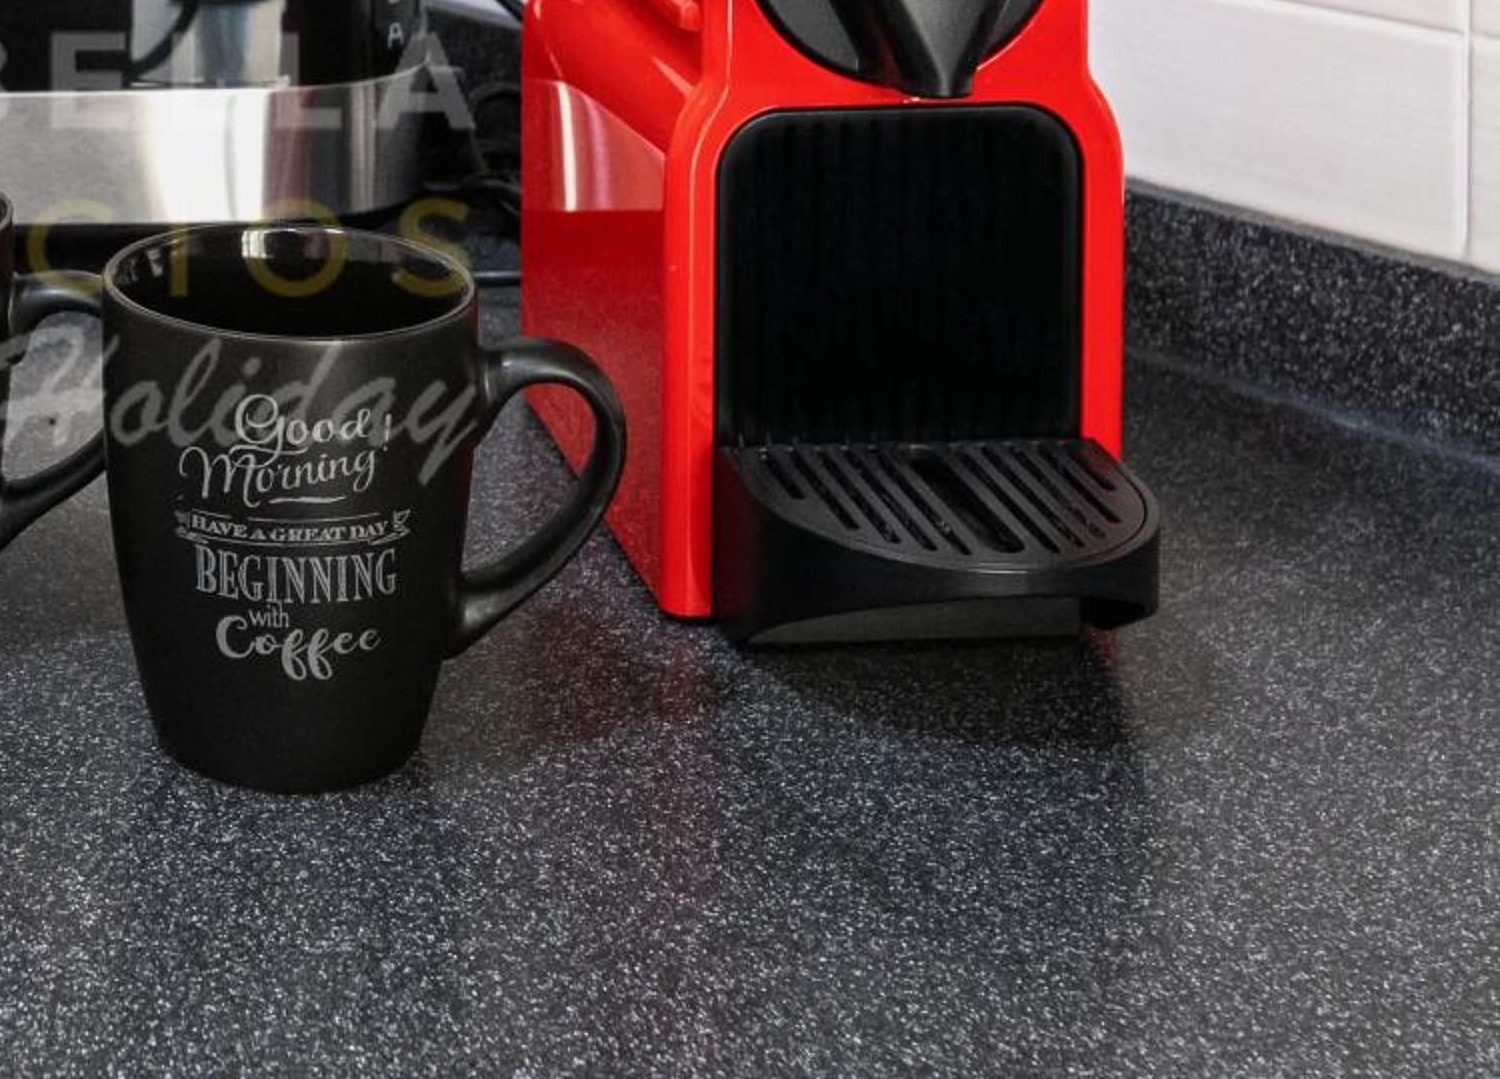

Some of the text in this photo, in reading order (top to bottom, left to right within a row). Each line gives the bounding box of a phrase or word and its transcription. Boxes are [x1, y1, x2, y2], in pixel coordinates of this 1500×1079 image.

[191, 514, 389, 542] HAVE A GREAT DAY
[196, 544, 397, 603] BEGINNING
[250, 601, 289, 628] with
[216, 615, 381, 680] Coffee
